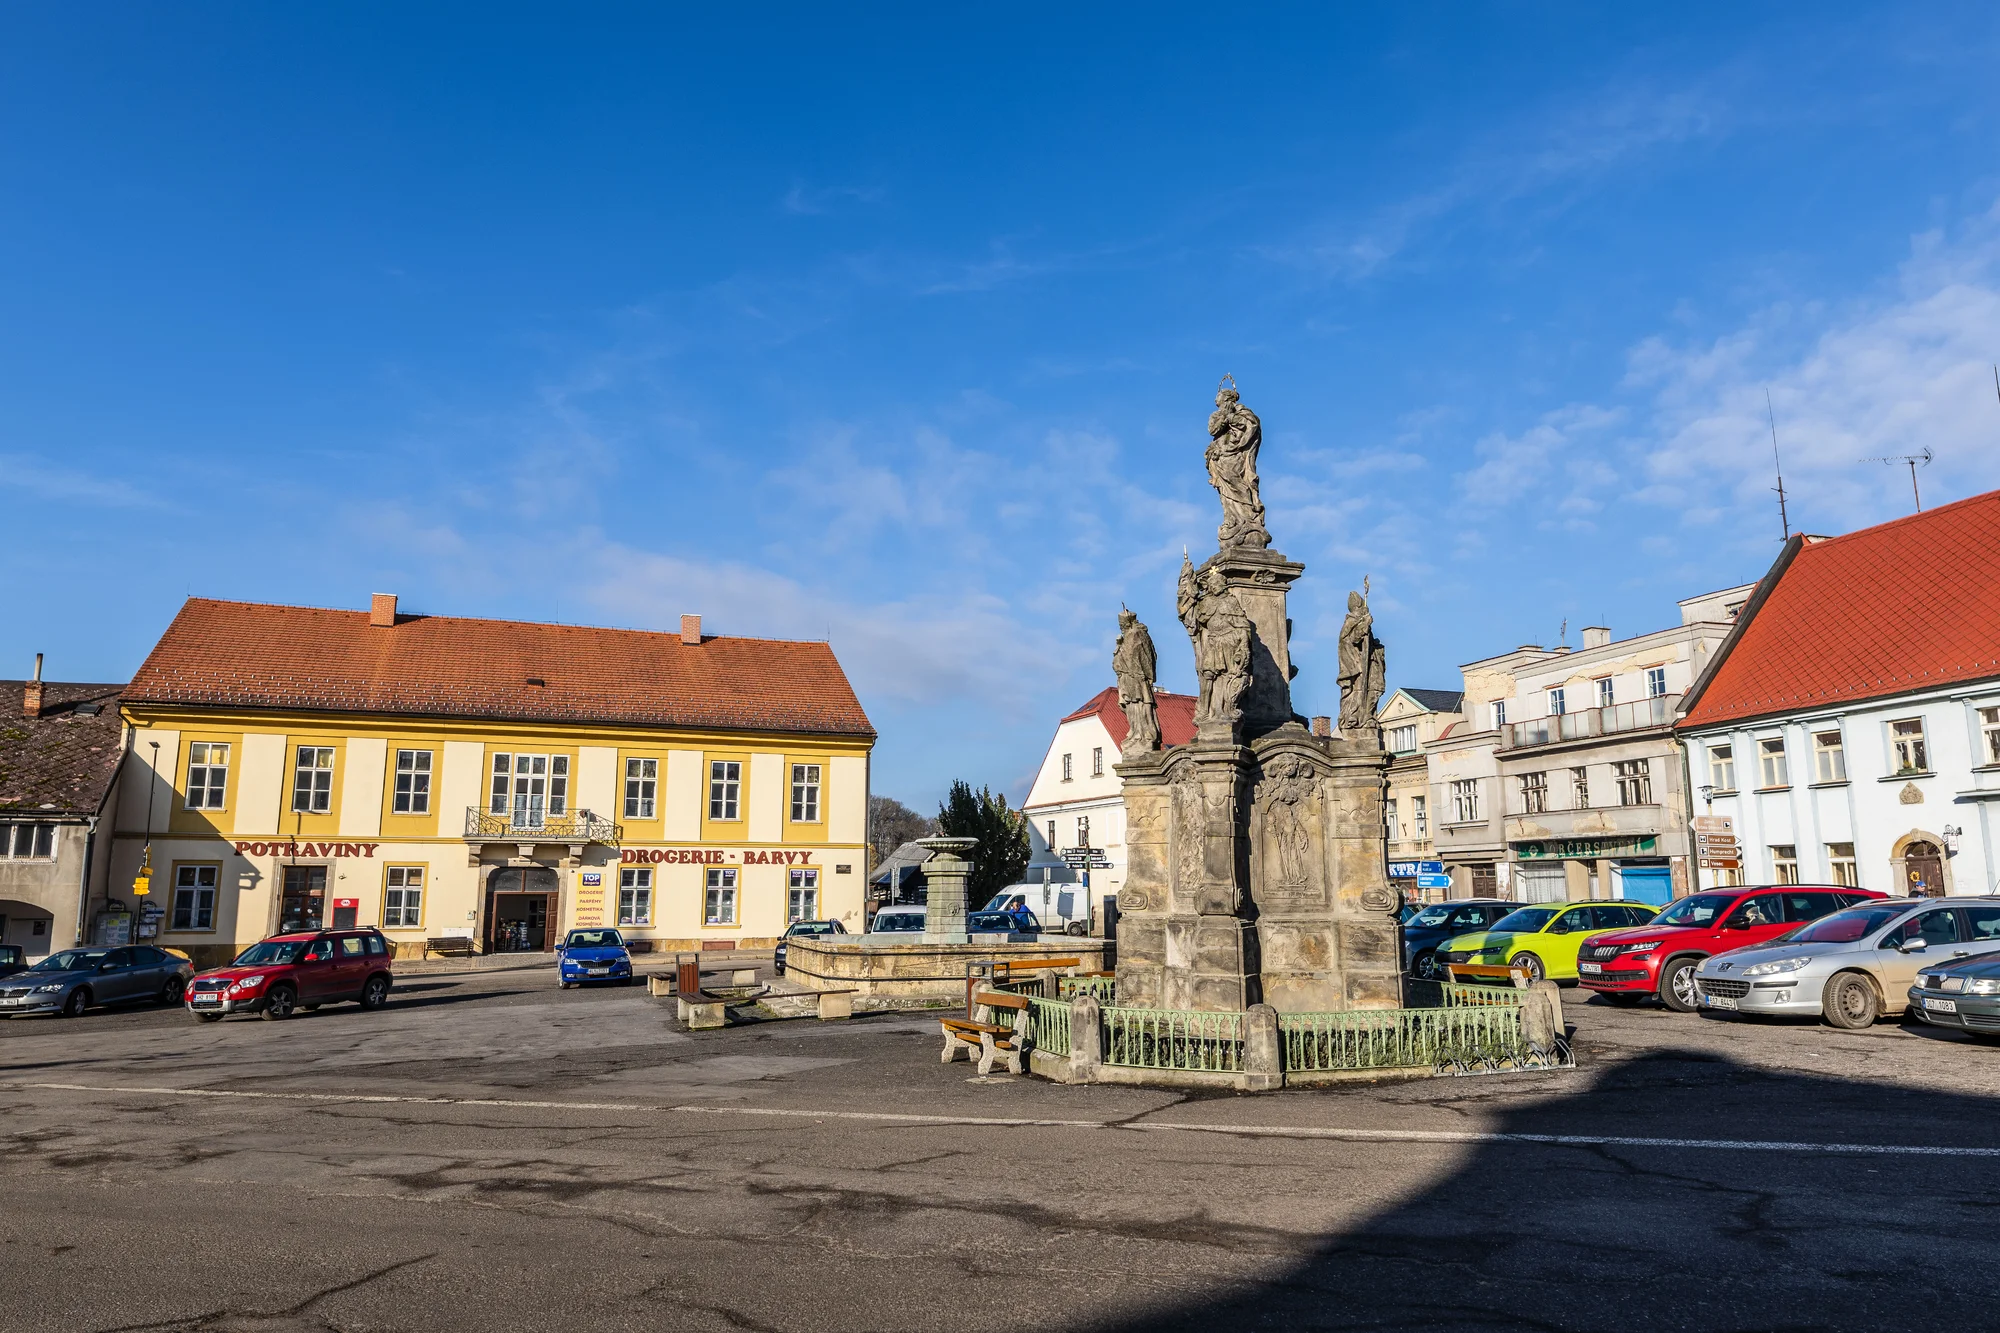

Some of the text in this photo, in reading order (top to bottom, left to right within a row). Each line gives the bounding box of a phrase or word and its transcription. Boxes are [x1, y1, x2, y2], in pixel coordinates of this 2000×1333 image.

[234, 841, 379, 857] POTRAVINY
[621, 849, 724, 864] DROGERIE
[743, 851, 813, 865] BARVY
[1938, 1001, 1953, 1010] 1083
